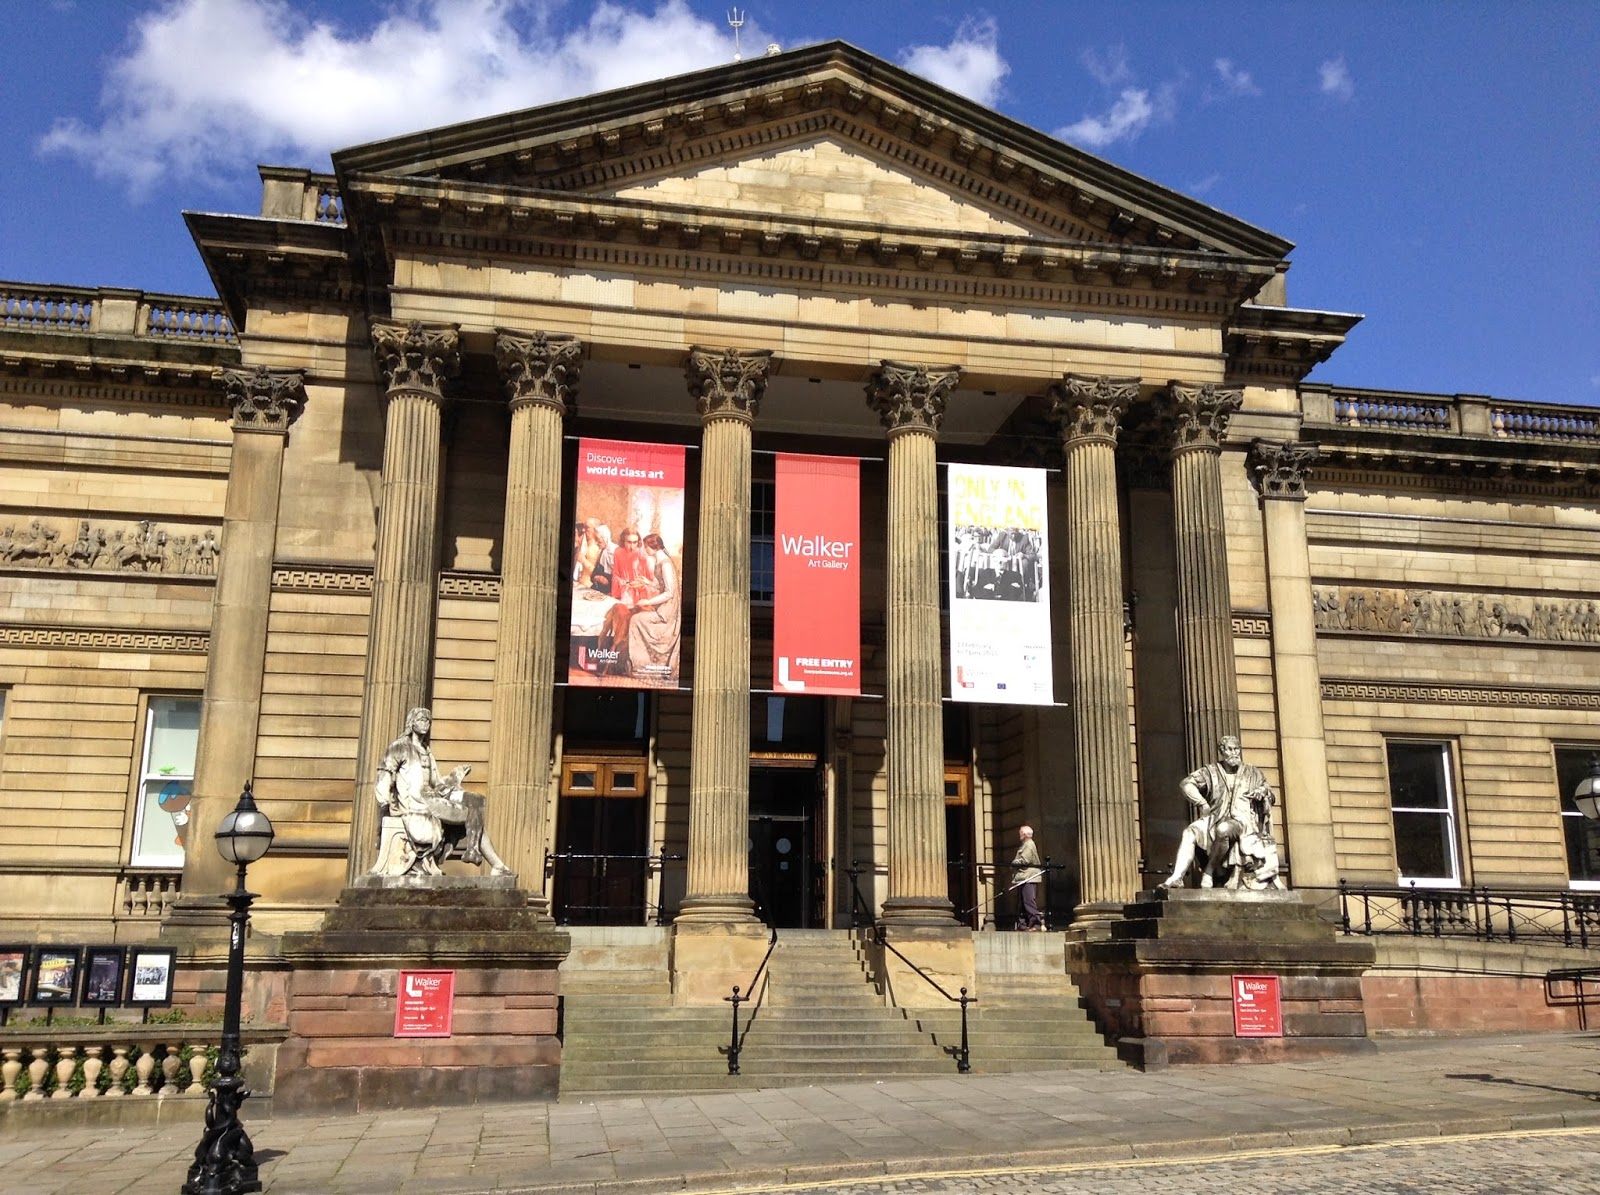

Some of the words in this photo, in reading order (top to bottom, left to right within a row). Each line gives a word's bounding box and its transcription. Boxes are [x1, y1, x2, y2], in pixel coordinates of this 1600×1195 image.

[586, 452, 627, 464] Discover
[586, 466, 618, 476] world
[620, 468, 646, 478] class
[648, 470, 664, 479] art
[781, 533, 854, 558] Walker
[808, 559, 820, 568] Art
[822, 560, 848, 571] Gallery
[588, 648, 620, 659] Walker
[795, 657, 820, 666] FREE
[821, 658, 853, 669] ENTRY
[415, 978, 441, 986] Walker
[1245, 982, 1268, 990] Walker
